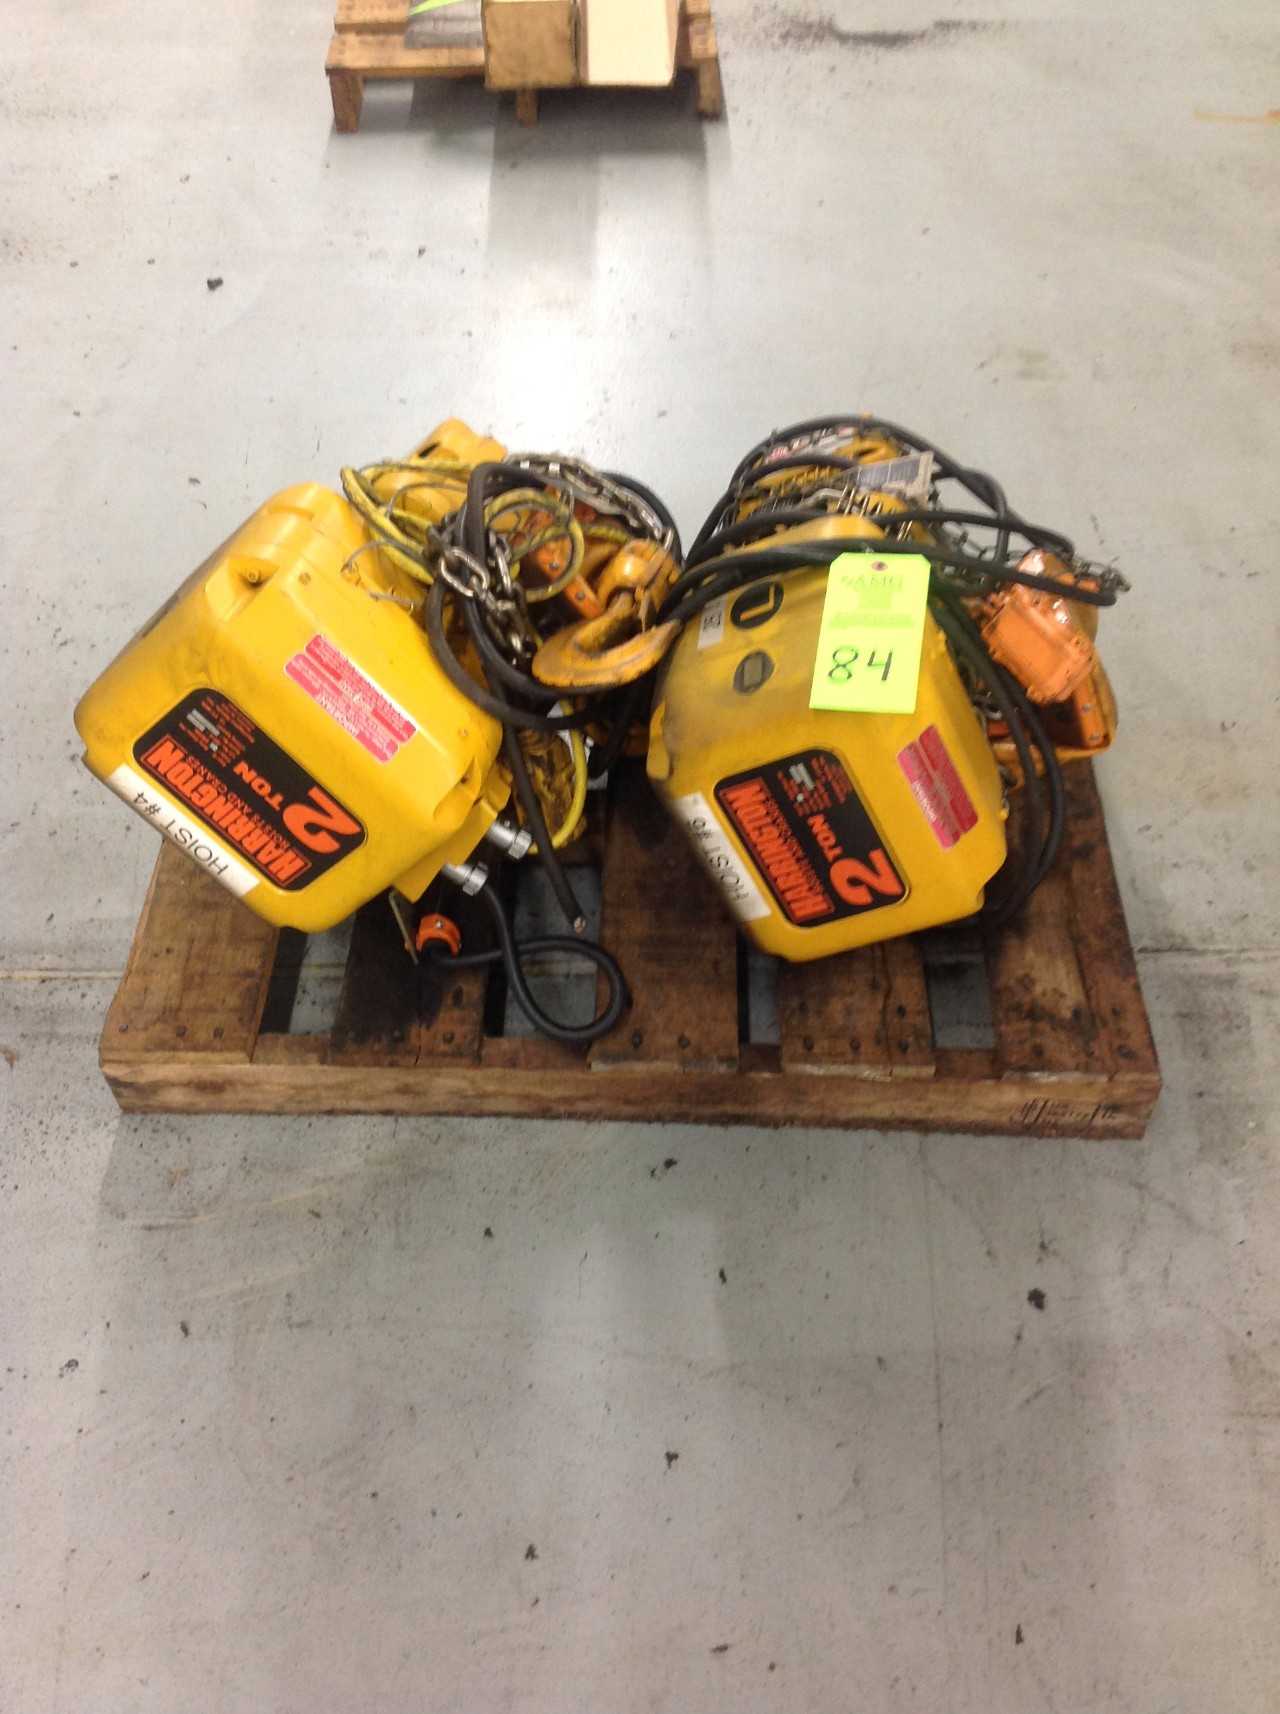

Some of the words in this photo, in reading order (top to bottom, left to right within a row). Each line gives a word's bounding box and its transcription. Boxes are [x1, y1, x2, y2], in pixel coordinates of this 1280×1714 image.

[828, 646, 893, 683] 84
[133, 791, 161, 817] #4
[147, 738, 306, 882] HARRINGTON
[233, 761, 284, 811] TON
[160, 819, 229, 876] HOIST
[283, 785, 361, 854] 2
[808, 813, 843, 862] TON
[723, 778, 832, 920] HARRINGTON
[830, 848, 902, 906] 2
